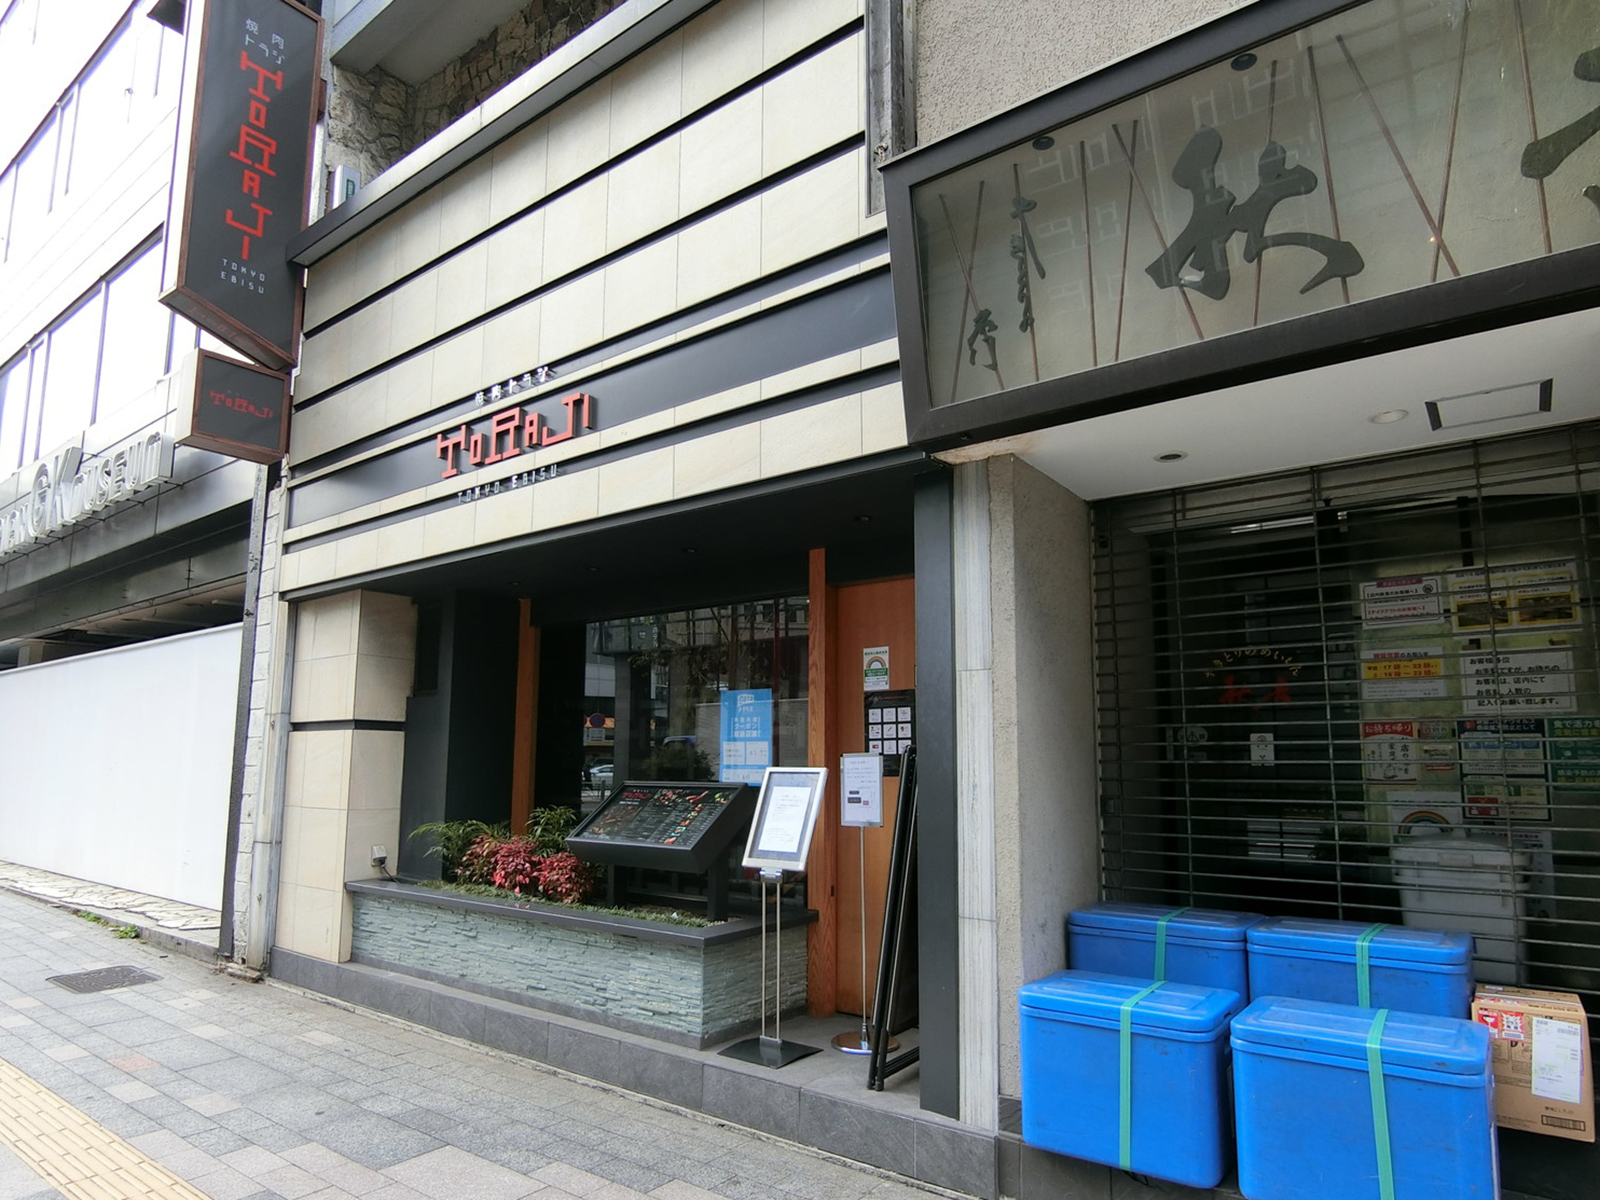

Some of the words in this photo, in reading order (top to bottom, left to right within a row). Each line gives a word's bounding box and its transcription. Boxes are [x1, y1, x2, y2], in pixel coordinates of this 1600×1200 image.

[244, 34, 285, 65] トラジ
[226, 51, 284, 261] TORAJI
[220, 270, 265, 294] EBISU
[221, 258, 266, 282] TOKYO
[436, 392, 593, 479] TORAJI
[457, 481, 501, 503] TOKYO
[511, 464, 558, 488] EBISU
